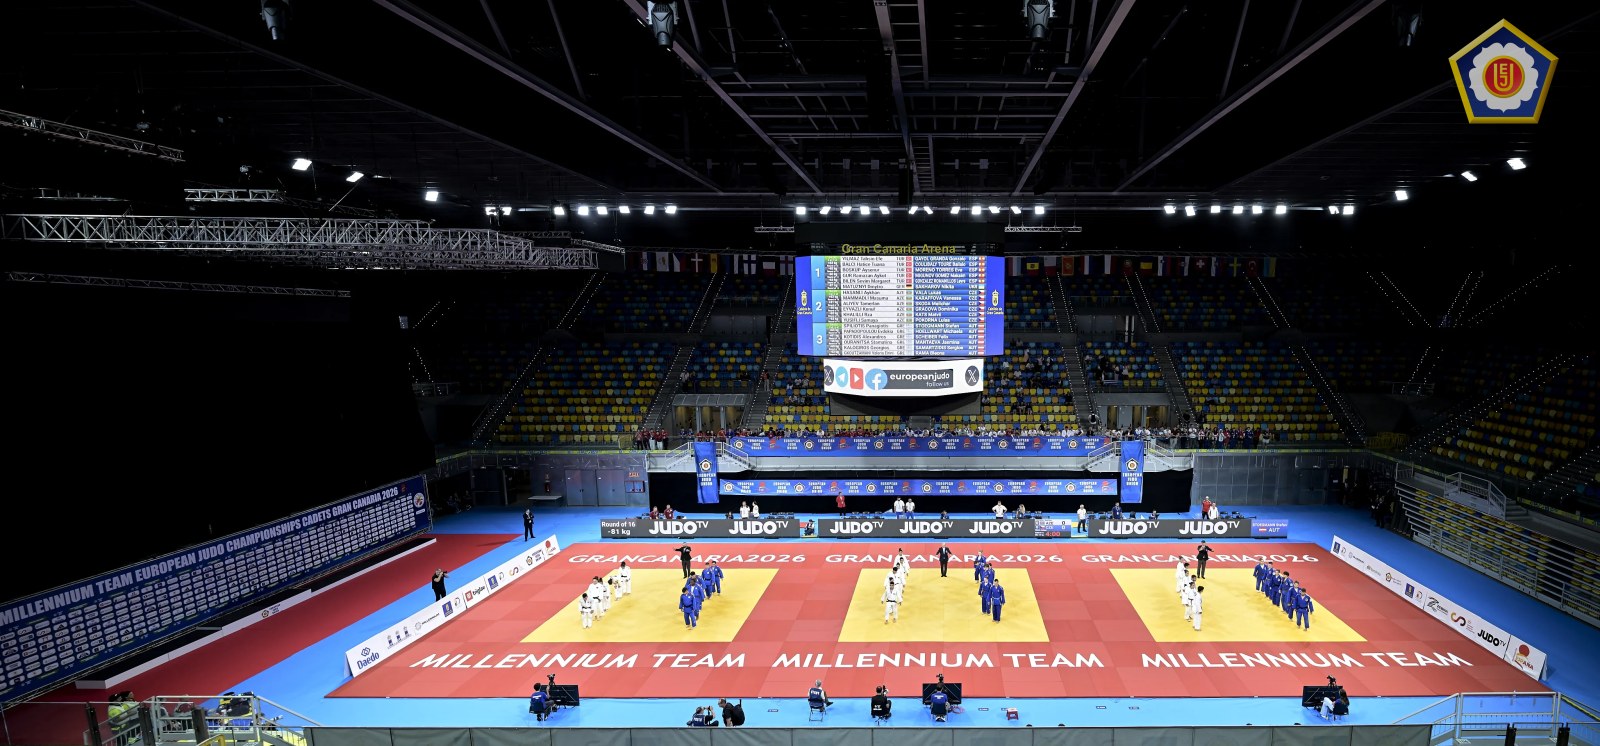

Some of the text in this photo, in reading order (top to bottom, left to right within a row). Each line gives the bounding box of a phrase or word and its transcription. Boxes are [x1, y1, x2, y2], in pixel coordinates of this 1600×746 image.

[842, 244, 956, 254] Gran Canaria Arena
[815, 268, 820, 277] 1
[816, 302, 822, 310] 2
[816, 335, 823, 344] 3
[890, 372, 950, 381] europeanjudo
[0, 486, 398, 626] MILLENNIUM TEAM EUROPEAN JUDO CHAMPIONSHIPS CADETS GRAN CANARIA 2026
[357, 652, 380, 669] Daedo
[409, 653, 746, 668] MILLENNIUM TEAM
[772, 653, 1104, 668] MILLENNIUM TEAM
[1142, 653, 1474, 668] MILLENNIUM TEAM
